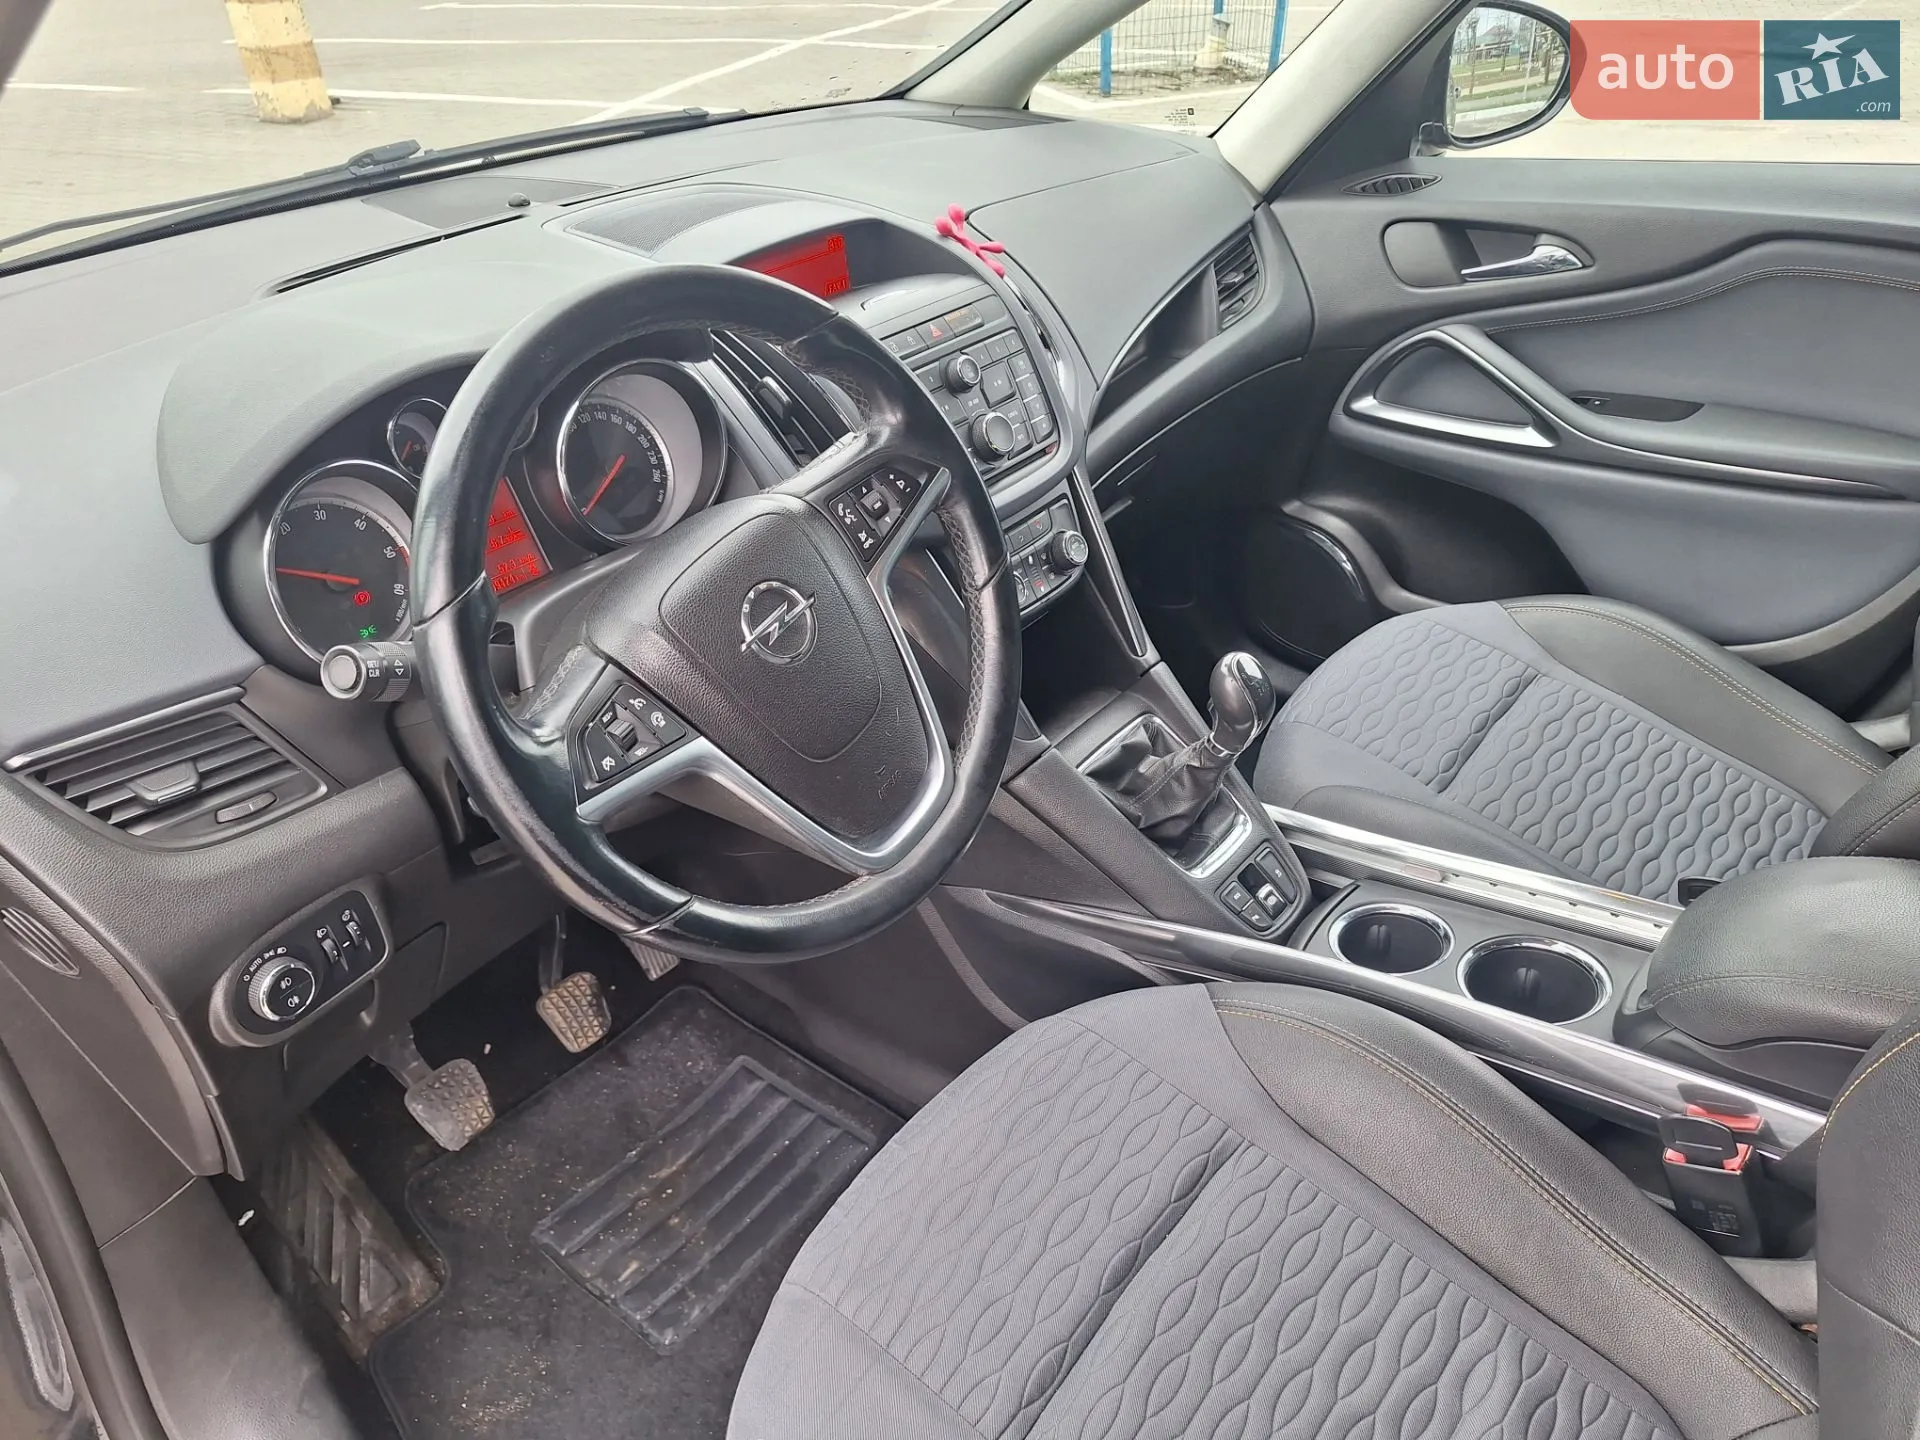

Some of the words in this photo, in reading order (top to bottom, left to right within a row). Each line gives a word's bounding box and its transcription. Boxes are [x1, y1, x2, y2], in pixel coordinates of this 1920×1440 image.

[578, 413, 591, 423] 120
[594, 411, 607, 420] 140
[610, 413, 622, 425] 160
[625, 421, 637, 434] 180
[638, 434, 650, 449] 200
[313, 509, 327, 521] 30
[279, 521, 291, 536] 20
[354, 519, 367, 531] 40
[383, 545, 396, 559] 50
[393, 583, 405, 596] 60
[249, 958, 263, 972] AUTO
